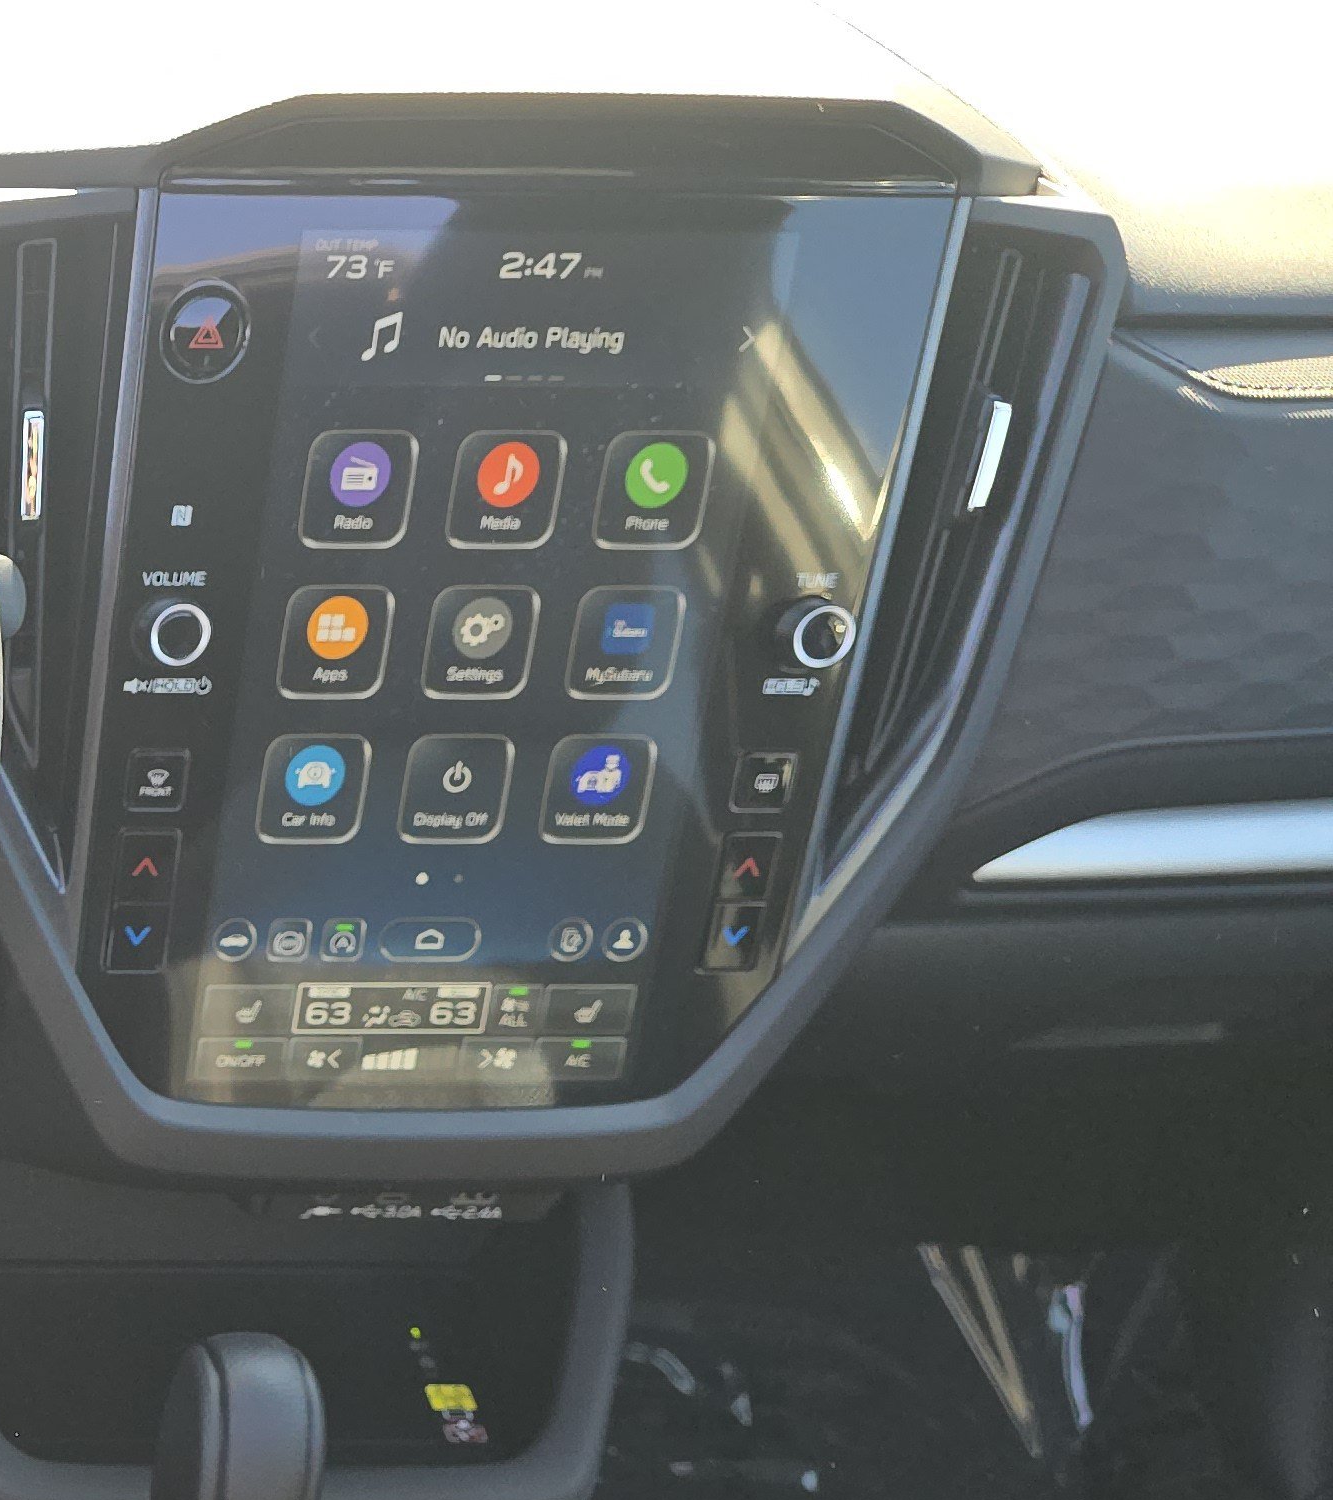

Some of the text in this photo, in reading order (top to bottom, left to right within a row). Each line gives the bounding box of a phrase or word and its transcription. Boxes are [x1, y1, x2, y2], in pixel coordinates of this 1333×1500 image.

[326, 255, 369, 279] 73
[499, 251, 582, 280] 2:47
[438, 326, 626, 355] No Audio Playing
[141, 571, 208, 587] VOLUME
[313, 667, 349, 684] Apps
[305, 1001, 353, 1025] 63
[429, 1001, 477, 1026] 63
